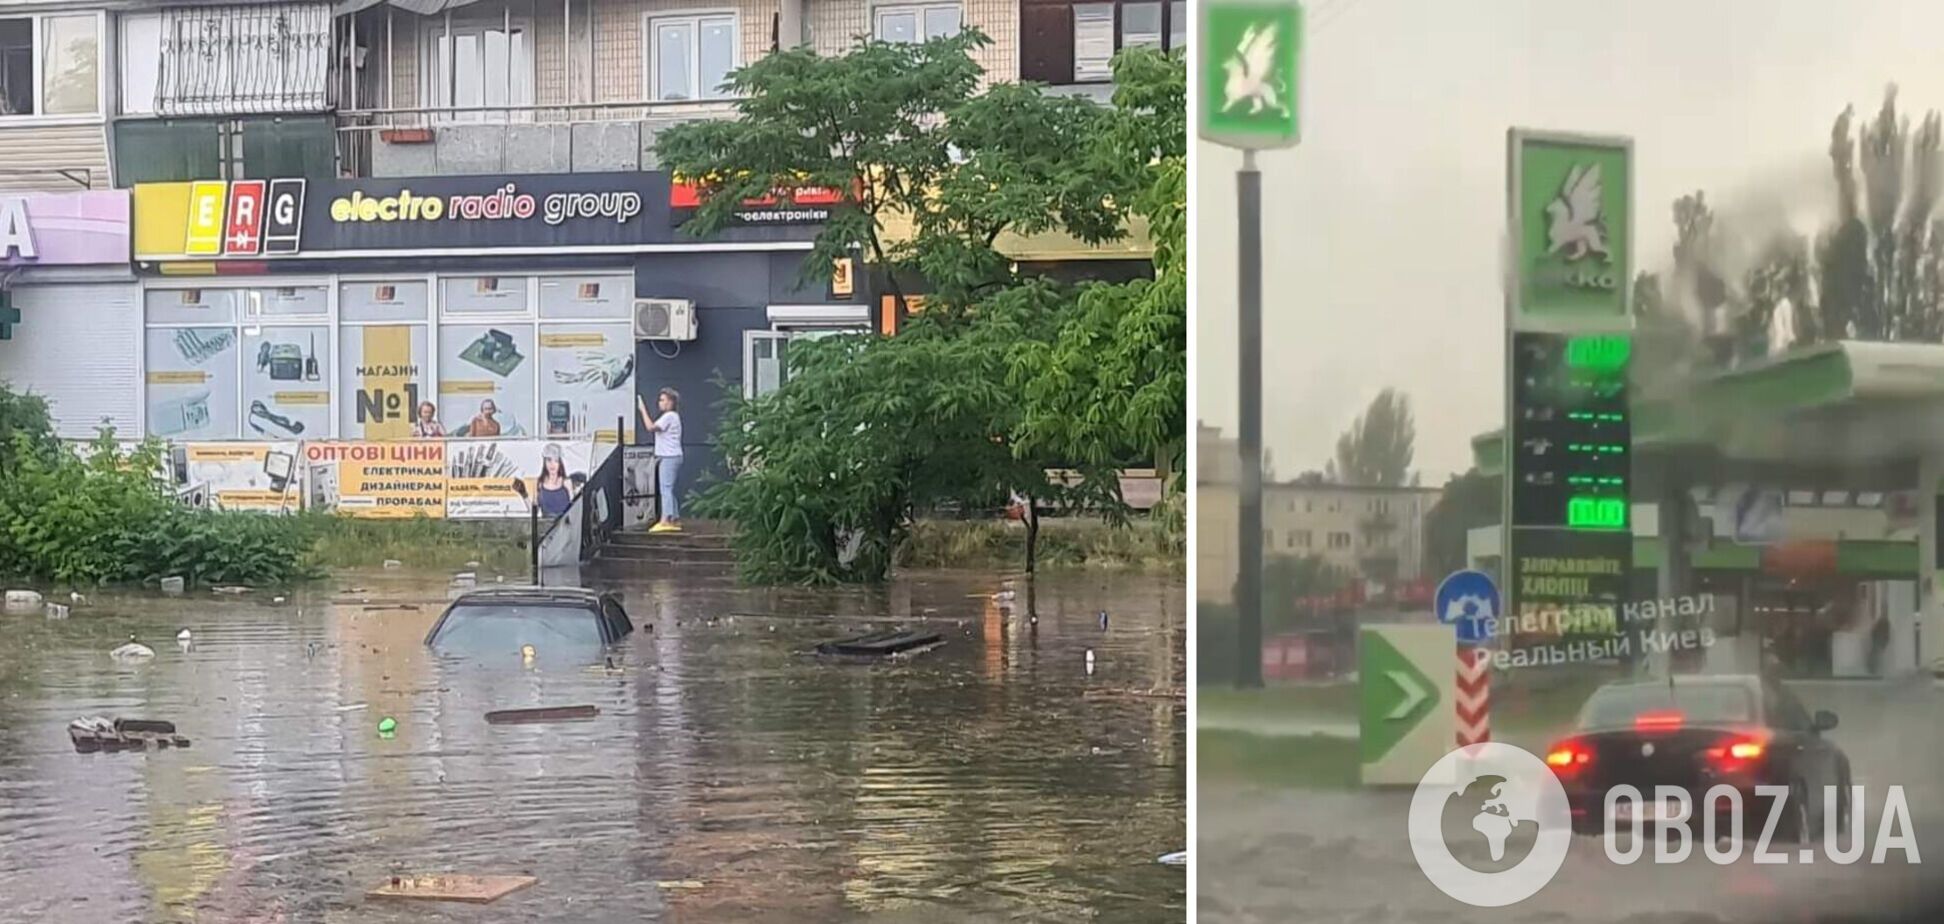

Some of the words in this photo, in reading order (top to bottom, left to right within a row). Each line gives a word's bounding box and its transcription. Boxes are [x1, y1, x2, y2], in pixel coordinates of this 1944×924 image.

[198, 193, 294, 227] ERG
[331, 190, 443, 222] electro
[449, 184, 536, 220] radio
[544, 191, 641, 225] group
[356, 365, 418, 377] МАГАЗИН
[307, 446, 385, 461] ОПТОВІ
[391, 446, 442, 463] ЦІНИ
[363, 466, 442, 476] ЕЛЕКТРИКАМ
[360, 480, 442, 492] ДИЗАЙНЕРАМ
[376, 497, 442, 506] ПРОРАБАМ
